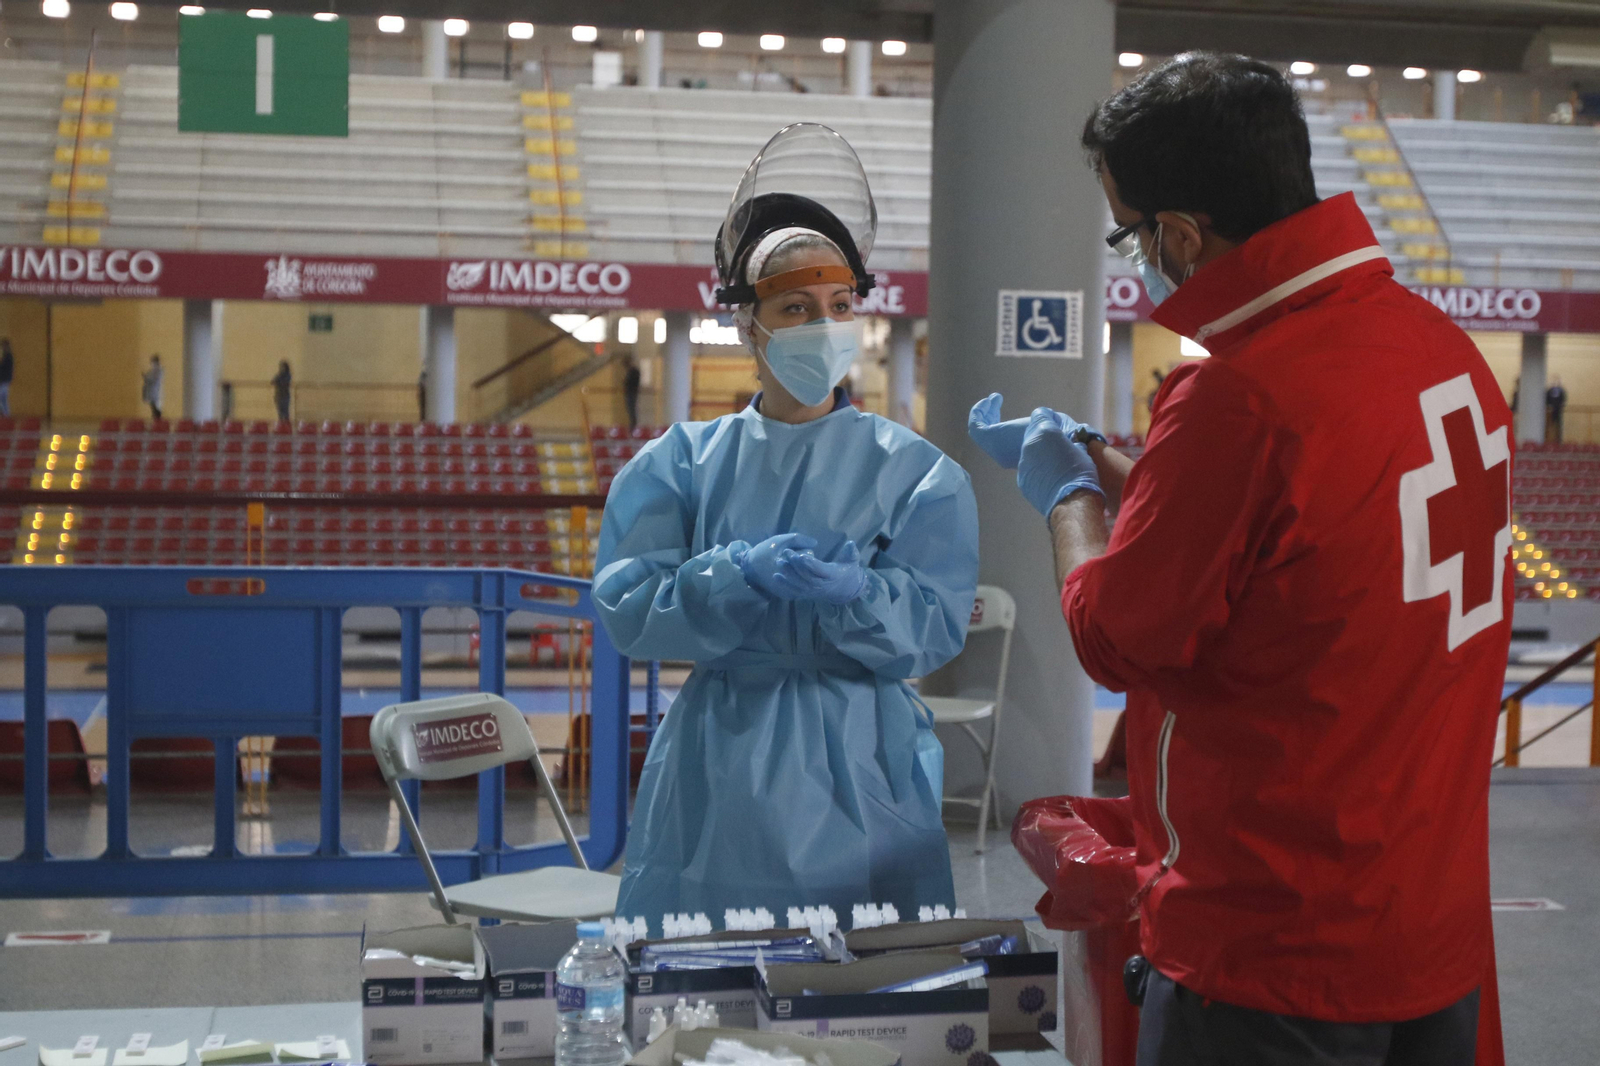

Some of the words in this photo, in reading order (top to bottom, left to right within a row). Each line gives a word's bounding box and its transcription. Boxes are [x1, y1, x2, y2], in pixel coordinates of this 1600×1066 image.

[11, 248, 162, 283] IMDECO
[490, 261, 631, 294] IMDECO
[430, 719, 497, 745] IMDECO
[830, 1029, 856, 1038] RAPID
[857, 1028, 875, 1036] TEST
[876, 1026, 907, 1036] DEVICE
